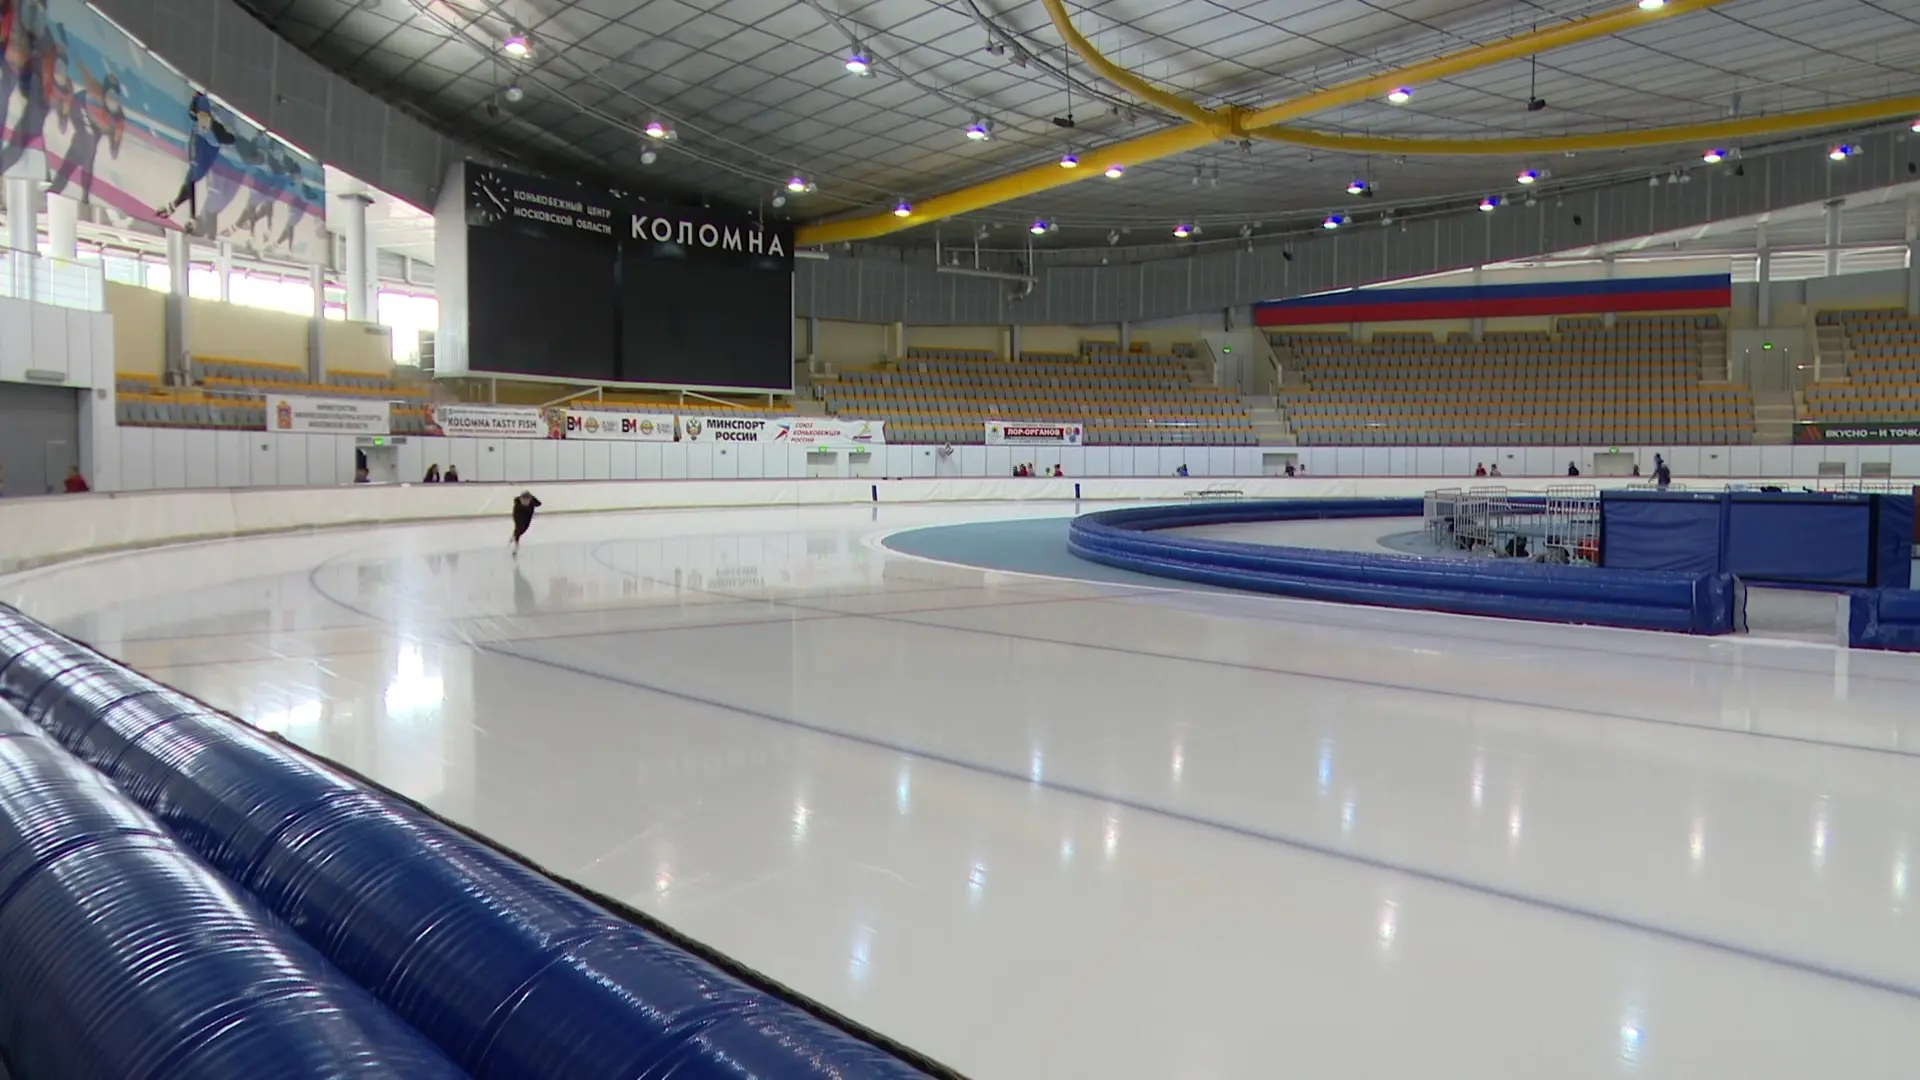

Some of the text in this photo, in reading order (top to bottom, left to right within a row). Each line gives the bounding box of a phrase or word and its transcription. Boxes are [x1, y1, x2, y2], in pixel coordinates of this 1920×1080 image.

[513, 190, 611, 218] КОНЬКОБЕЖНЫЙ ЦЕНТР
[513, 207, 611, 234] МОСКОВСКОЙ ОБЛАСТИ
[631, 214, 785, 257] КОЛОМНА
[448, 418, 537, 429] KOLOMNA TASTY FISH
[707, 419, 765, 430] МИНСПОРТ
[715, 431, 757, 441] РОССИИ
[1825, 429, 1868, 437] ВКУСНО
[1879, 429, 1887, 437] И
